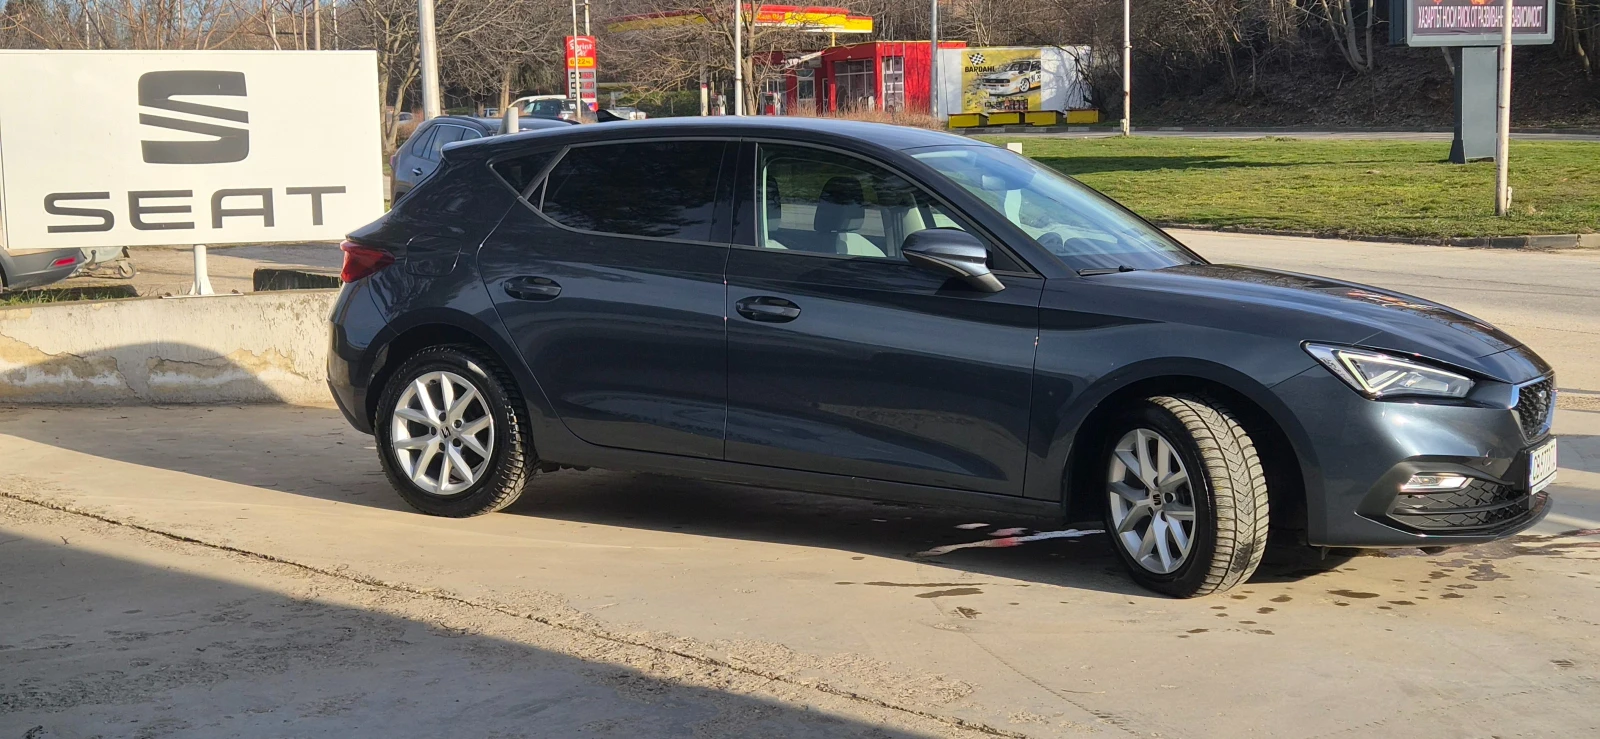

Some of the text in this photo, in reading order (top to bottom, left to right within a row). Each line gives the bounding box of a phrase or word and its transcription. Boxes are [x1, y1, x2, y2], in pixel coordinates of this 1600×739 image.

[1418, 5, 1442, 28] ХАЗАРТЪТ
[1443, 5, 1457, 28] НОСИ
[1458, 5, 1470, 28] РИСК
[1471, 5, 1478, 28] ОТ
[1478, 5, 1504, 28] РАЗВИВАНЕ
[44, 186, 346, 233] SEAT
